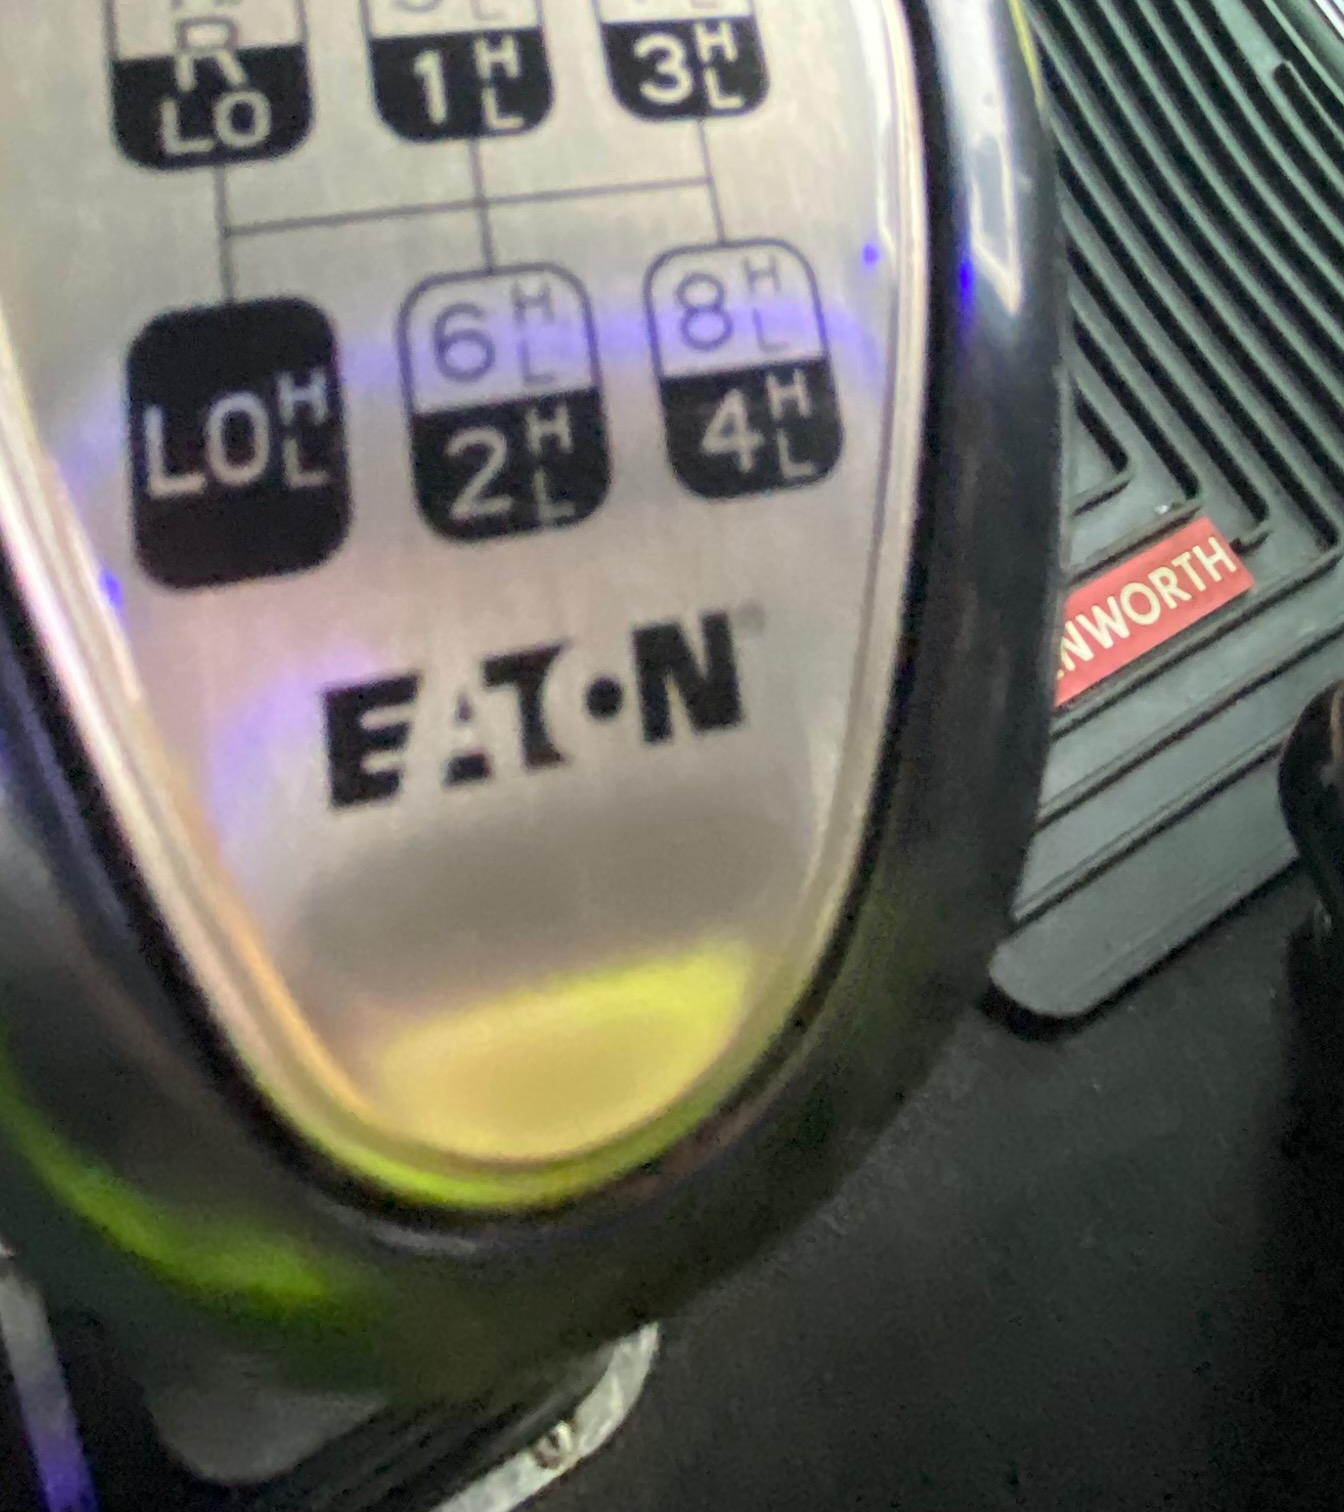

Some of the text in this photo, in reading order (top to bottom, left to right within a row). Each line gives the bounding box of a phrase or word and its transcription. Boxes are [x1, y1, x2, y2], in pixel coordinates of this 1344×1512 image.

[174, 15, 246, 91] R
[473, 38, 522, 79] H
[634, 33, 690, 102] 3
[695, 24, 737, 63] H
[414, 49, 447, 124] 1
[481, 87, 524, 131] L
[706, 69, 747, 110] L
[159, 91, 272, 155] LO
[746, 257, 782, 295] H
[513, 283, 555, 326] H
[674, 272, 733, 352] 8
[753, 307, 789, 354] L
[430, 302, 496, 383] 6
[518, 339, 557, 388] L
[278, 367, 328, 426] H
[766, 368, 810, 420] H
[143, 390, 271, 498] LO
[524, 405, 573, 457] H
[700, 388, 765, 473] 4
[775, 426, 817, 477] L
[283, 433, 332, 489] L
[444, 430, 516, 524] 2
[533, 471, 577, 528] L
[1056, 537, 1237, 679] NWORTH
